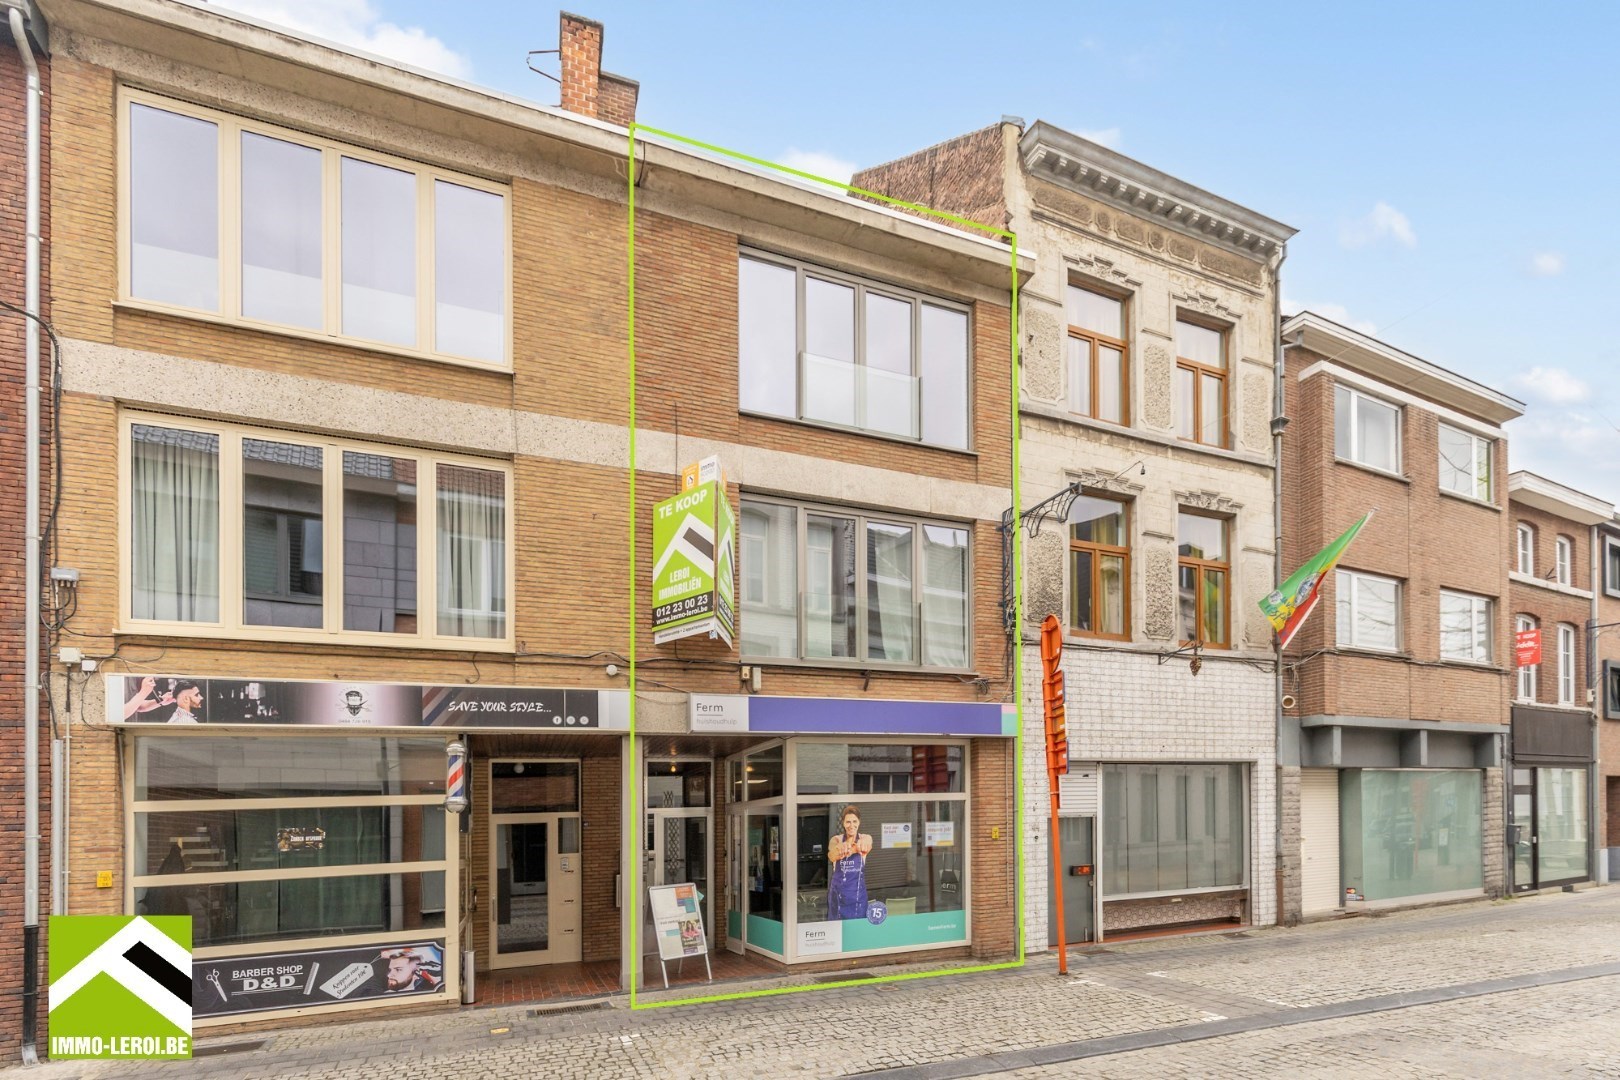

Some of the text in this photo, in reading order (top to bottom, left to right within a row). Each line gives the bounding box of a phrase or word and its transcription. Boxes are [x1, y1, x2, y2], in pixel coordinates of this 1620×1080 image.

[659, 489, 708, 519] TE KOOP
[670, 566, 690, 584] LEROI
[659, 576, 702, 601] IMMOBILIËN
[656, 594, 708, 618] 012 23 00 23
[656, 605, 708, 625] www.immo-leroi.be
[448, 701, 552, 713] SAVE YOUR STYLE...
[696, 703, 723, 712] Ferm
[871, 907, 883, 918] 15
[805, 930, 826, 938] Ferm
[232, 964, 303, 979] BARBER SHOP
[243, 975, 296, 991] D&D
